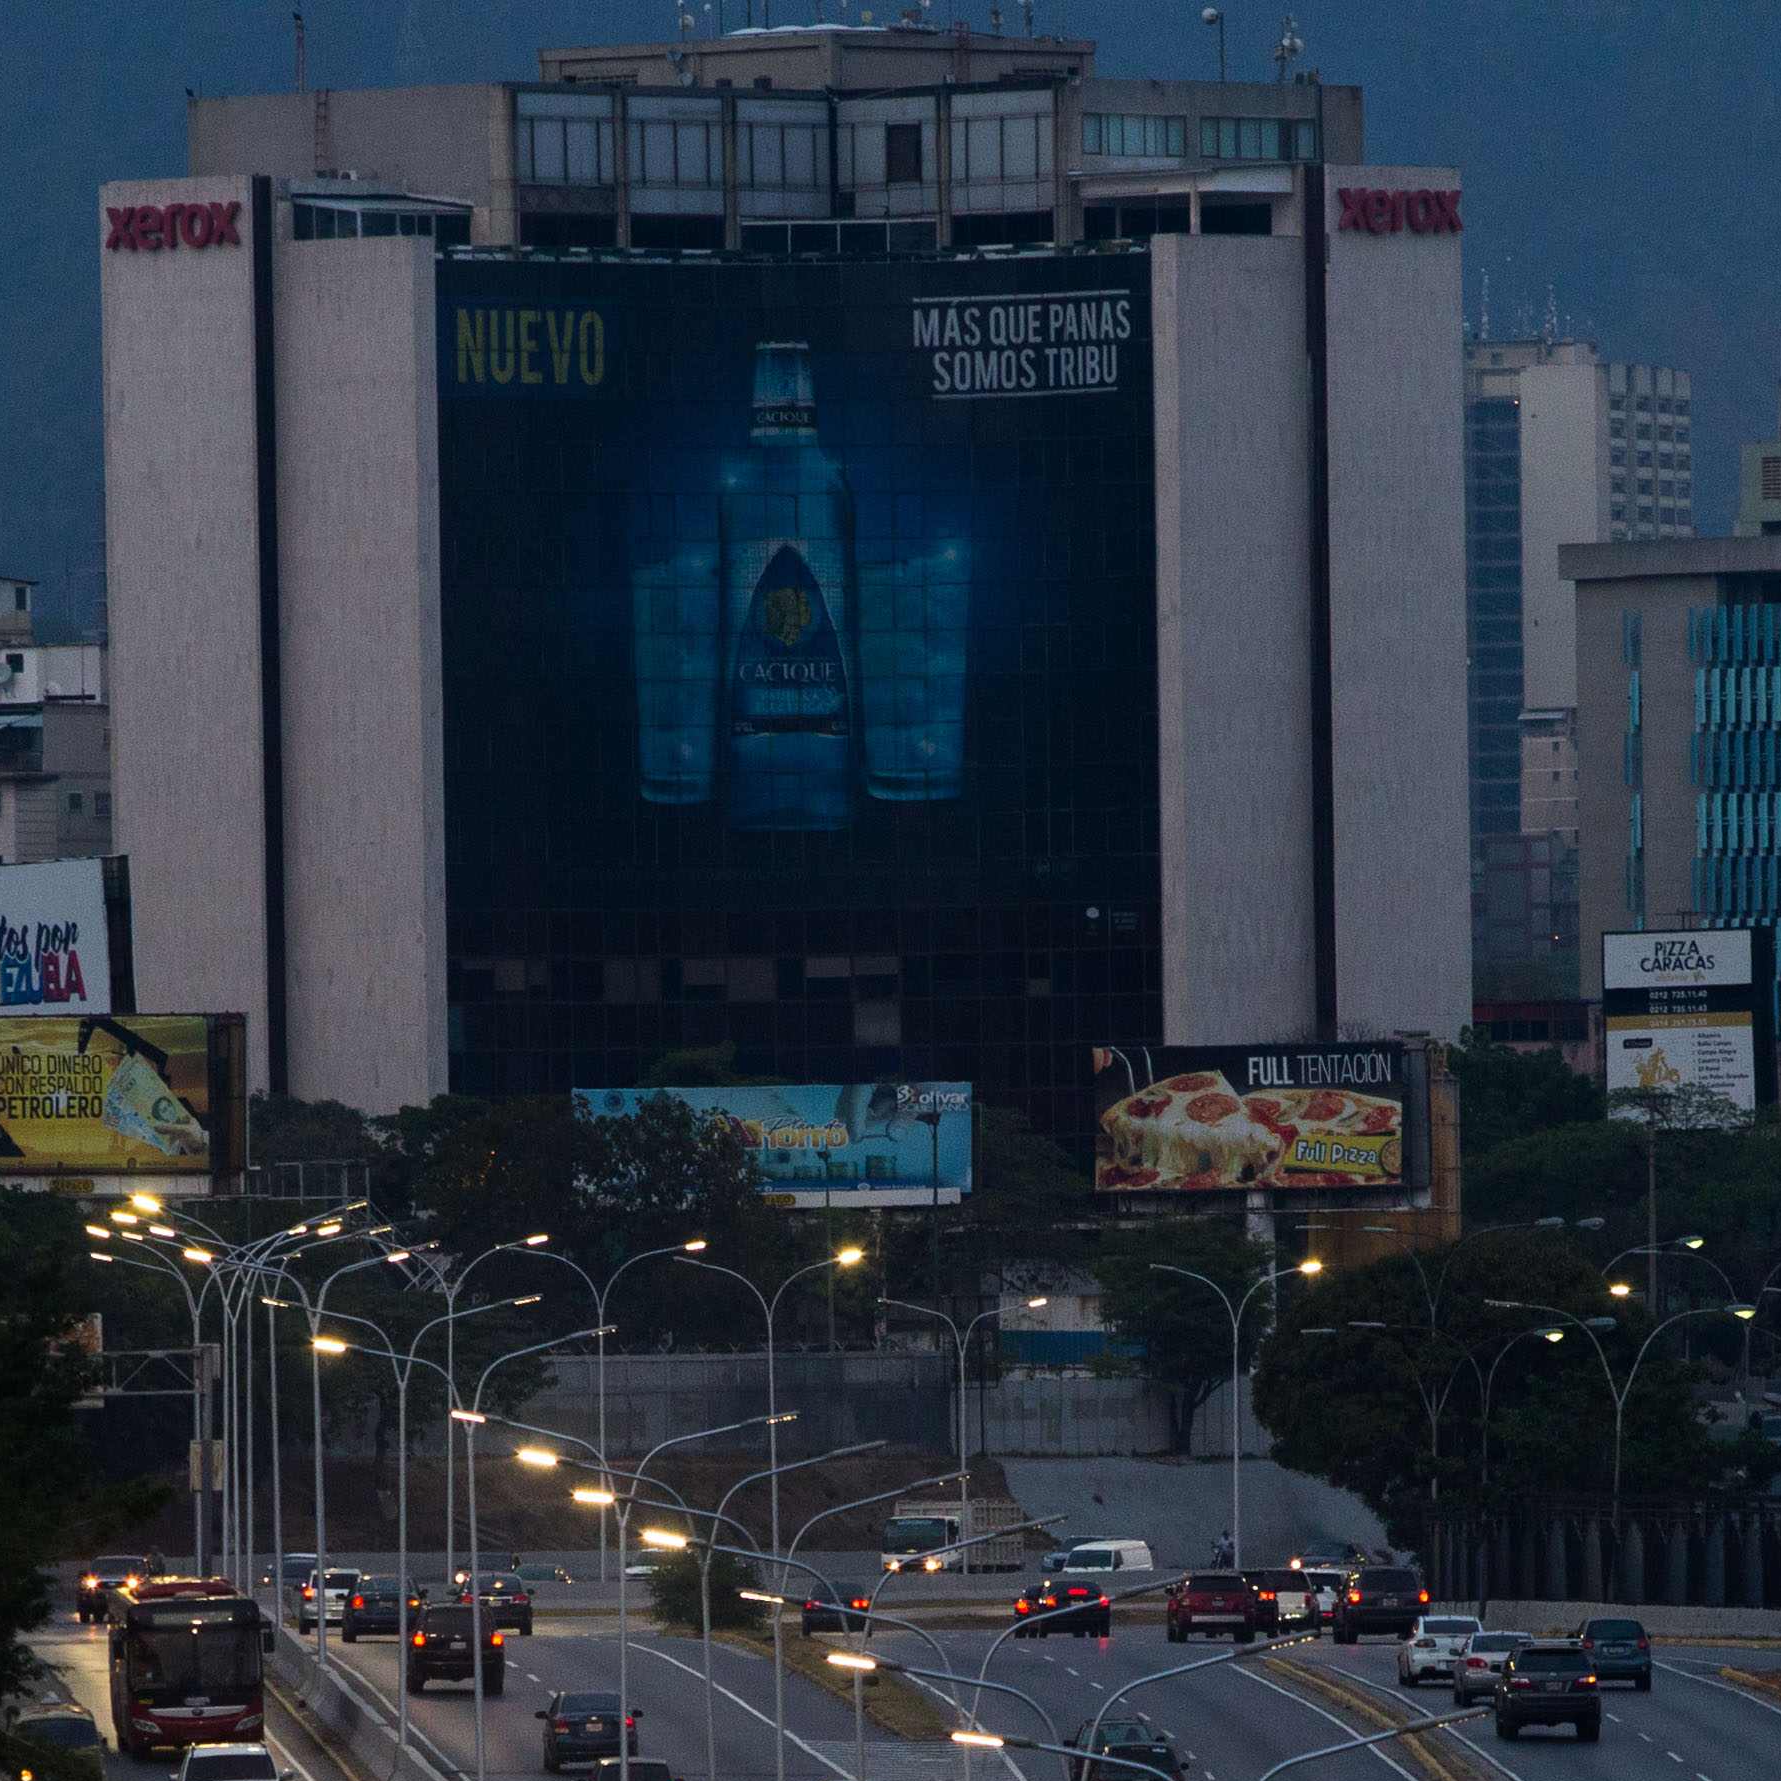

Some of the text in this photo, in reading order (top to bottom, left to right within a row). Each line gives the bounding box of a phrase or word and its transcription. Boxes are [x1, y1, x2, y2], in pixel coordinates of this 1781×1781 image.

[106, 201, 241, 252] xerox
[1336, 187, 1464, 236] xerox
[913, 300, 1131, 348] MÁS QUE PANAS
[456, 307, 605, 386] NUEVO
[932, 343, 1119, 392] SOMOS TRIBU
[756, 410, 811, 424] CACIQUE
[738, 662, 837, 683] CACIQUE
[35, 920, 79, 973] por
[1640, 955, 1715, 972] CARACAS
[47, 1054, 102, 1075] DINERO
[1247, 1049, 1392, 1086] FULL TENTACIÓN
[30, 1076, 102, 1095] RESPALDO
[1296, 1141, 1380, 1165] Full Pizza
